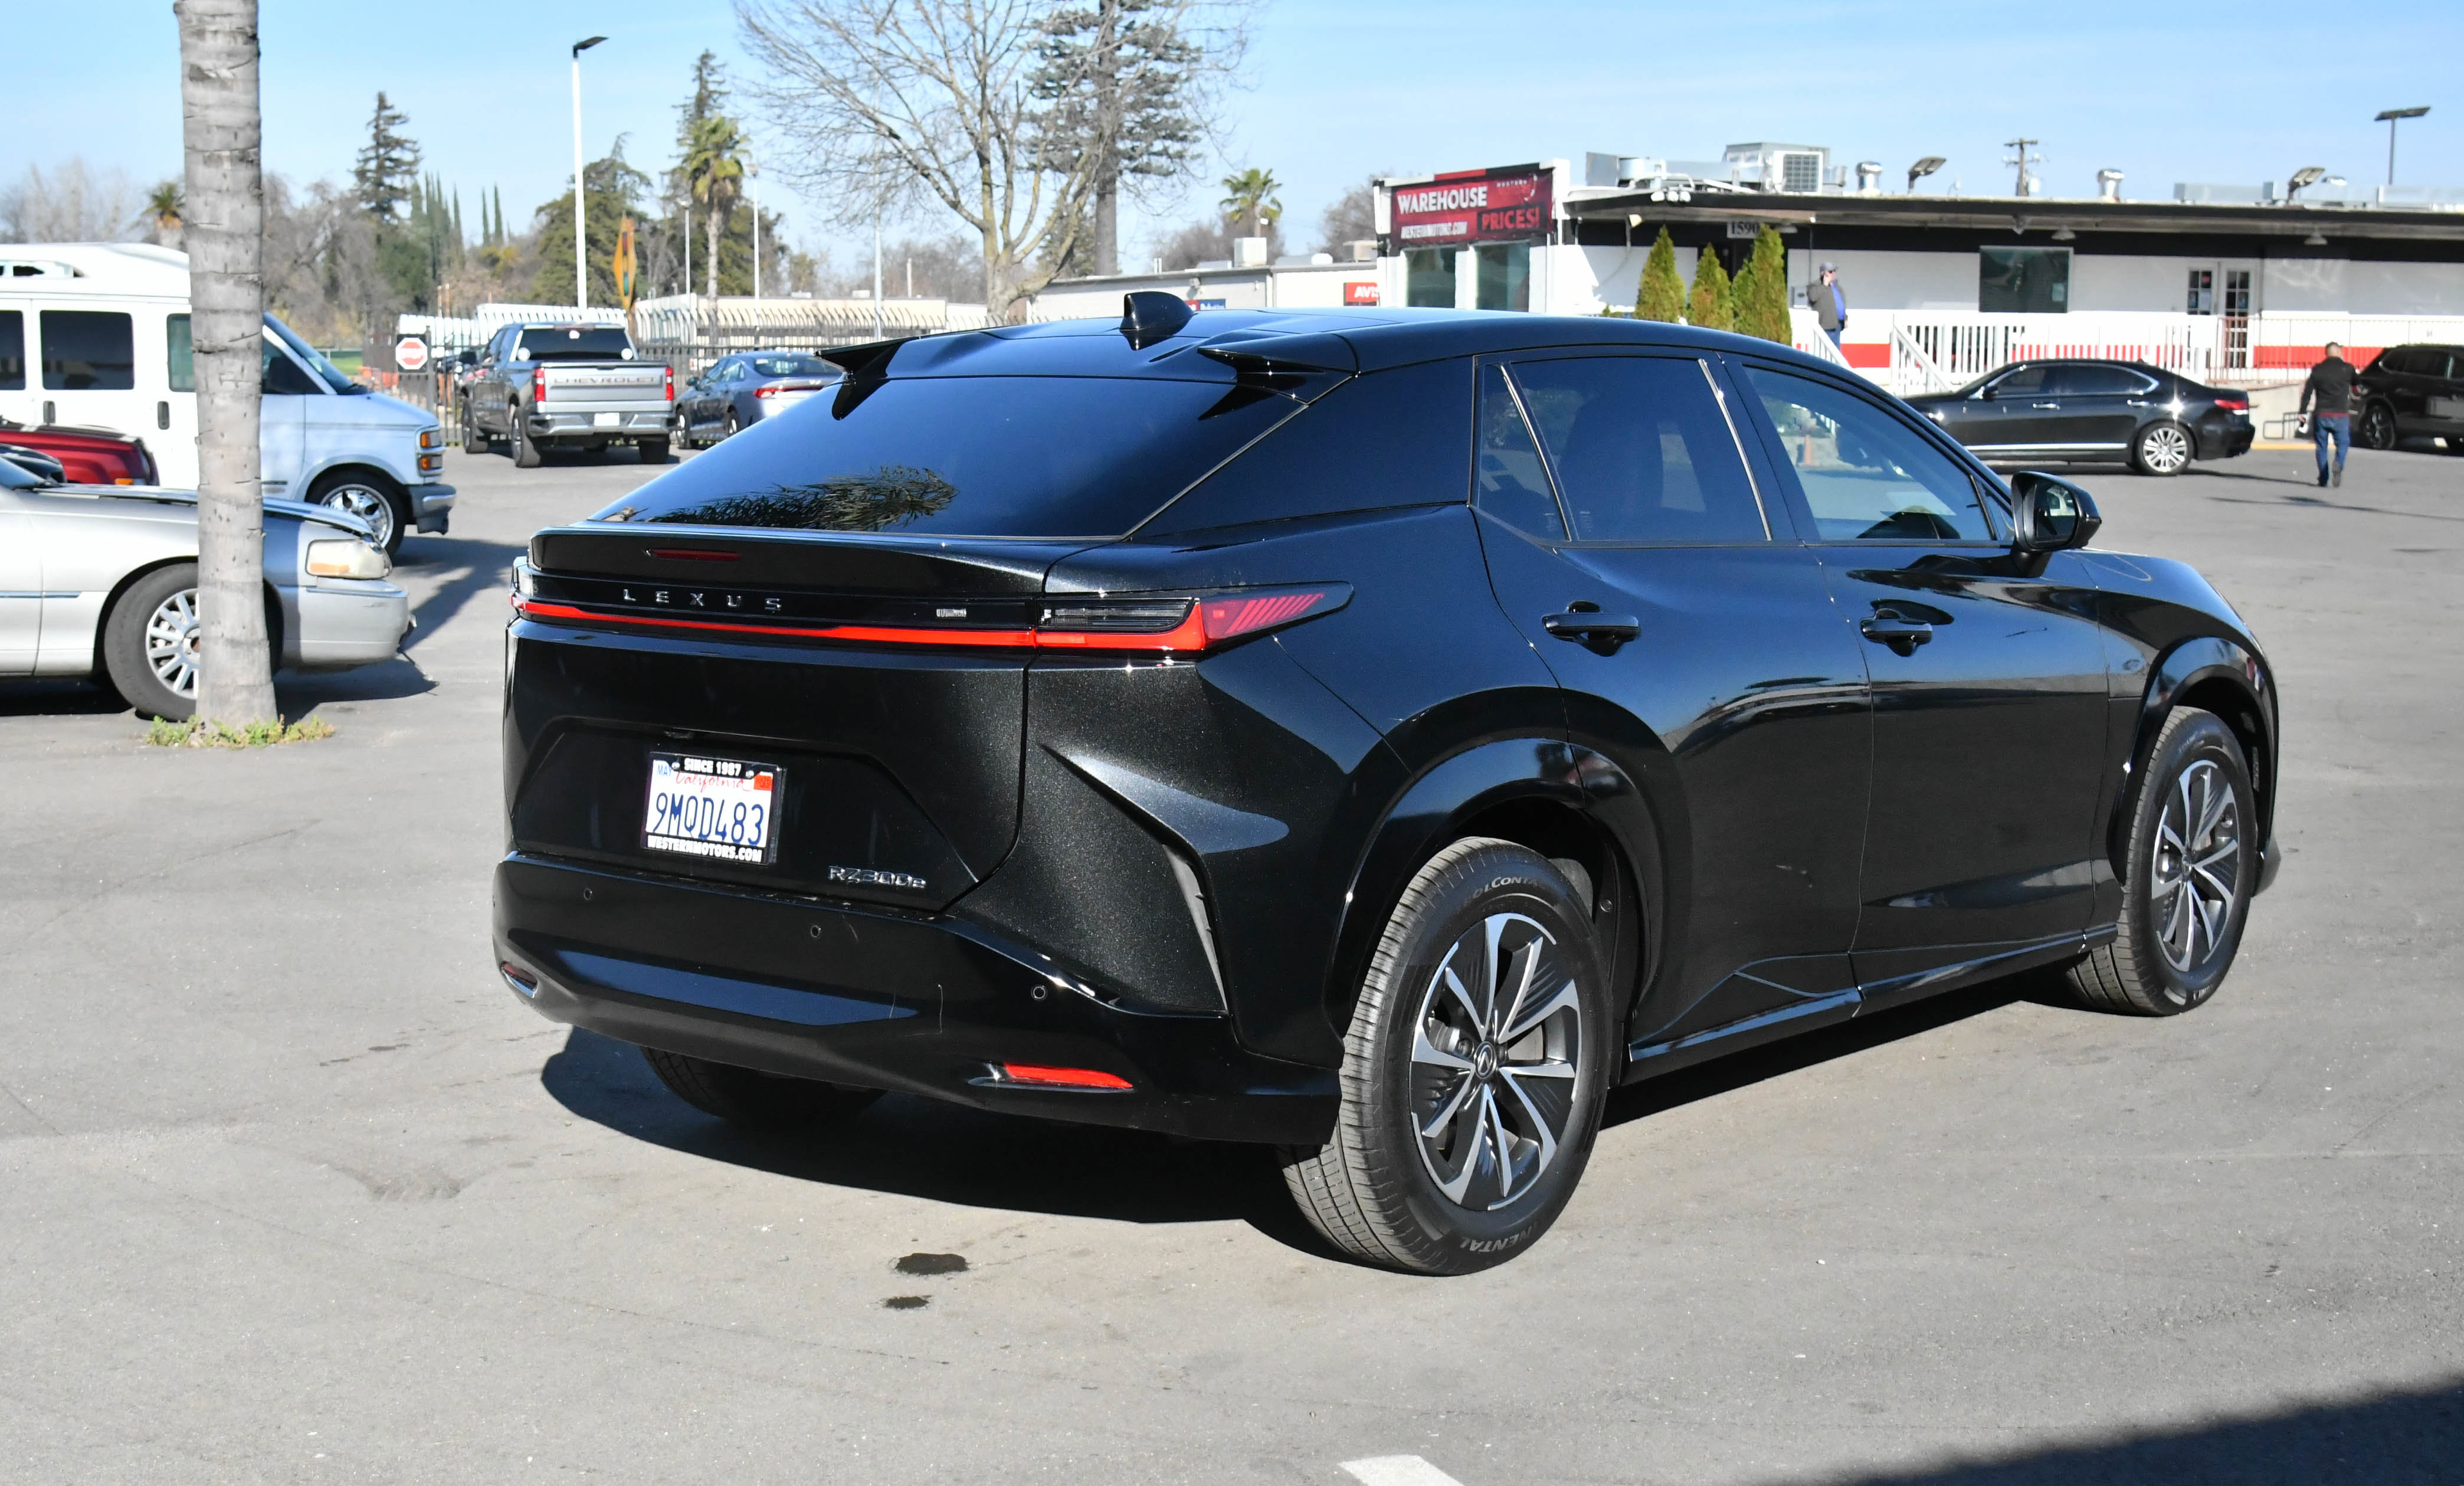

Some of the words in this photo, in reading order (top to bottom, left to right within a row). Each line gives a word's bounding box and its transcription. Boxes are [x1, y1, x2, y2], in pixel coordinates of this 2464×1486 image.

[1397, 186, 1487, 214] WAREHOUSE
[1482, 207, 1539, 230] PRICES!
[1732, 221, 1760, 234] 1590
[623, 589, 782, 611] LEXUS
[657, 764, 671, 777] MAY
[684, 758, 713, 773] SINCE
[716, 761, 741, 776] 1987
[676, 772, 751, 793] California
[653, 793, 764, 846] 9MQD483
[647, 834, 762, 862] WESTERNMOTORS.COM
